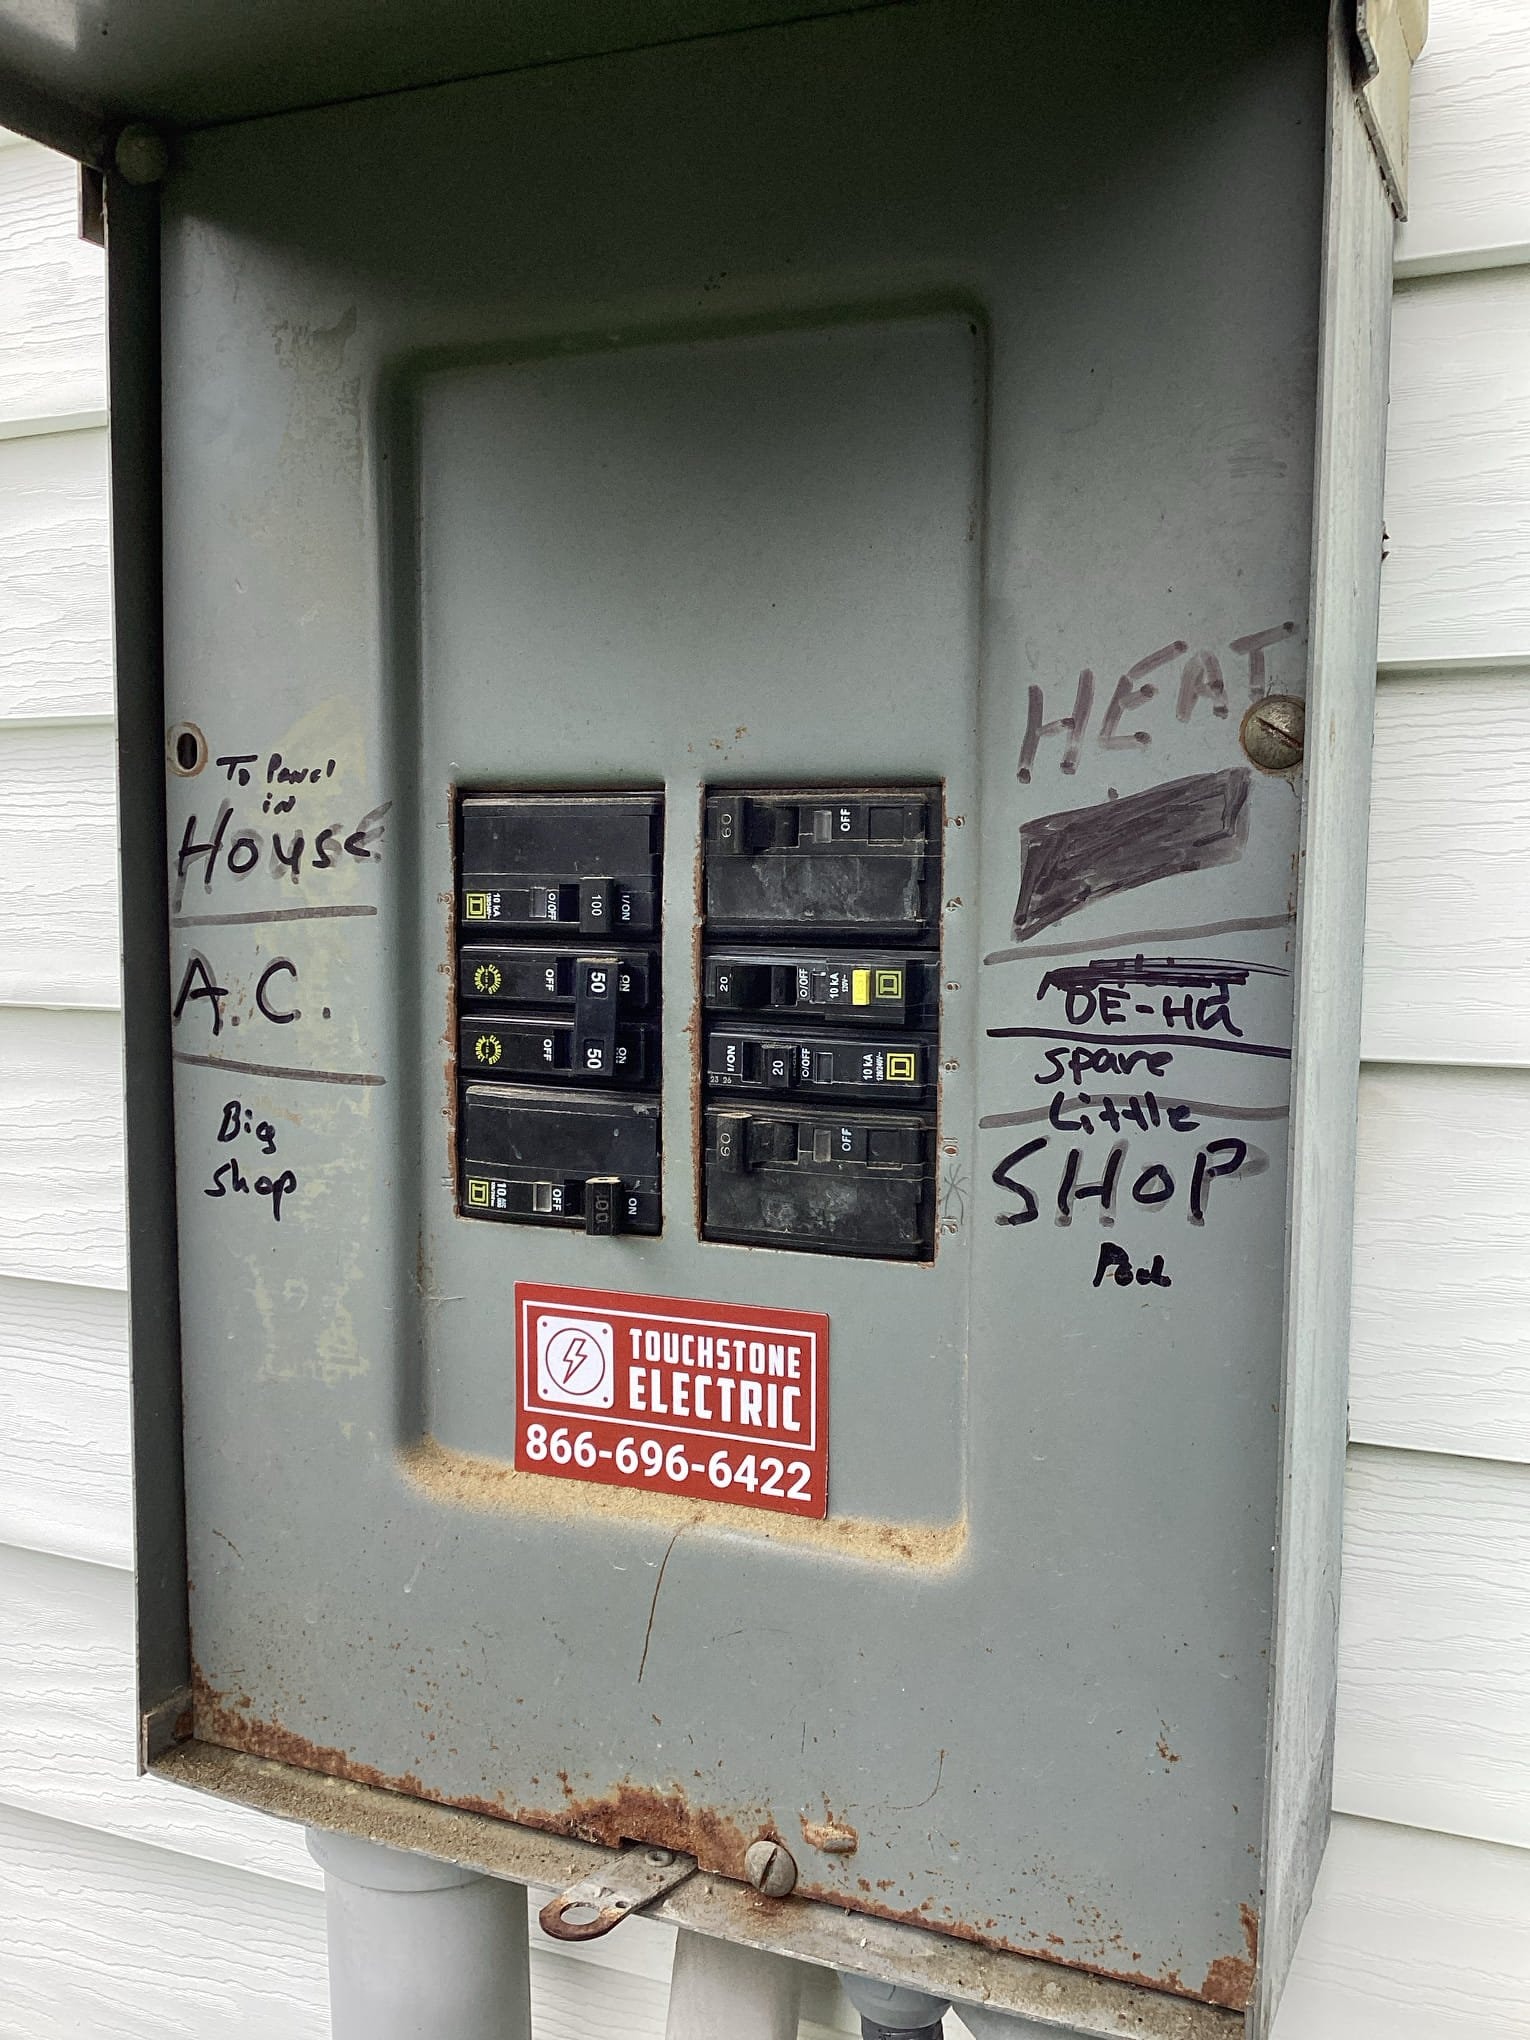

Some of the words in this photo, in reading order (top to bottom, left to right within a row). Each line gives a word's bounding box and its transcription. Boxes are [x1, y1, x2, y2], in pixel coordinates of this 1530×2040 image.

[1017, 621, 1295, 784] HEAT
[216, 754, 258, 786] To
[721, 813, 732, 837] 60
[840, 808, 851, 831] OFF
[493, 892, 501, 903] 10
[592, 894, 602, 916] 100
[493, 904, 501, 917] kA
[545, 968, 554, 992] OFF
[591, 971, 606, 993] 50
[622, 975, 630, 992] ON
[719, 976, 729, 992] 20
[829, 972, 839, 986] kA
[829, 987, 839, 999] 10
[543, 1039, 552, 1061] OFF
[587, 1047, 602, 1069] 50
[618, 1047, 627, 1064] ON
[863, 1053, 873, 1067] kA
[772, 1060, 784, 1076] 20
[863, 1069, 873, 1080] 10
[217, 1100, 277, 1154] Big
[720, 1132, 731, 1157] 60
[842, 1127, 852, 1151] OFF
[553, 1189, 562, 1212] OFF
[628, 1198, 637, 1215] ON
[629, 1328, 801, 1379] TOUCHSTONE
[629, 1366, 801, 1431] ELECTRIC
[526, 1423, 812, 1501] 866-696-6422
